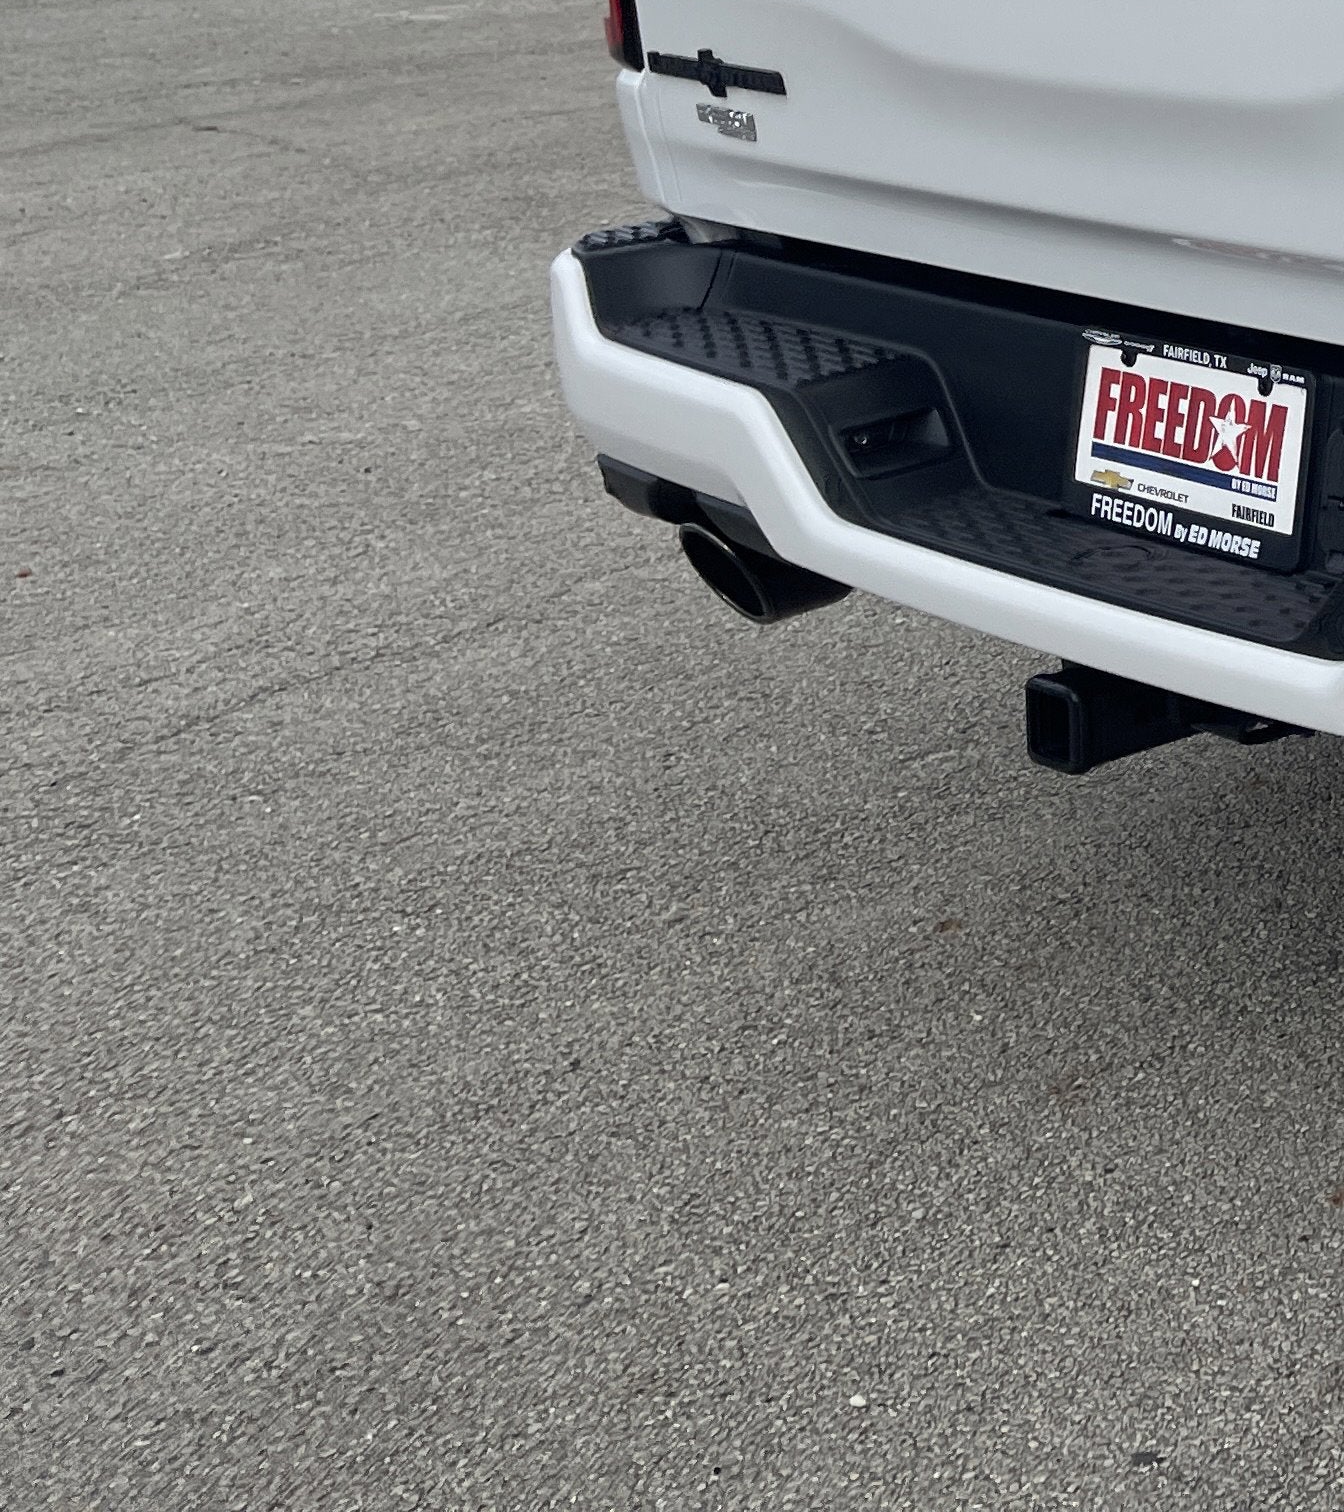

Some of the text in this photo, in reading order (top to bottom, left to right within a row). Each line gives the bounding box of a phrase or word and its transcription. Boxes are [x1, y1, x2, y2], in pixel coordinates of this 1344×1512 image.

[1162, 344, 1213, 369] FAIRFIELD,
[1214, 355, 1228, 368] TX
[1247, 363, 1268, 378] Jeep
[1282, 373, 1305, 384] RAM
[1137, 482, 1190, 504] CHEVROLET
[1231, 478, 1242, 490] BY
[1241, 480, 1252, 493] ED
[1090, 492, 1174, 537] FREEDOM
[1188, 524, 1208, 546] ED
[1208, 529, 1262, 560] MORSE
[1231, 502, 1276, 528] FAIRFIELD
